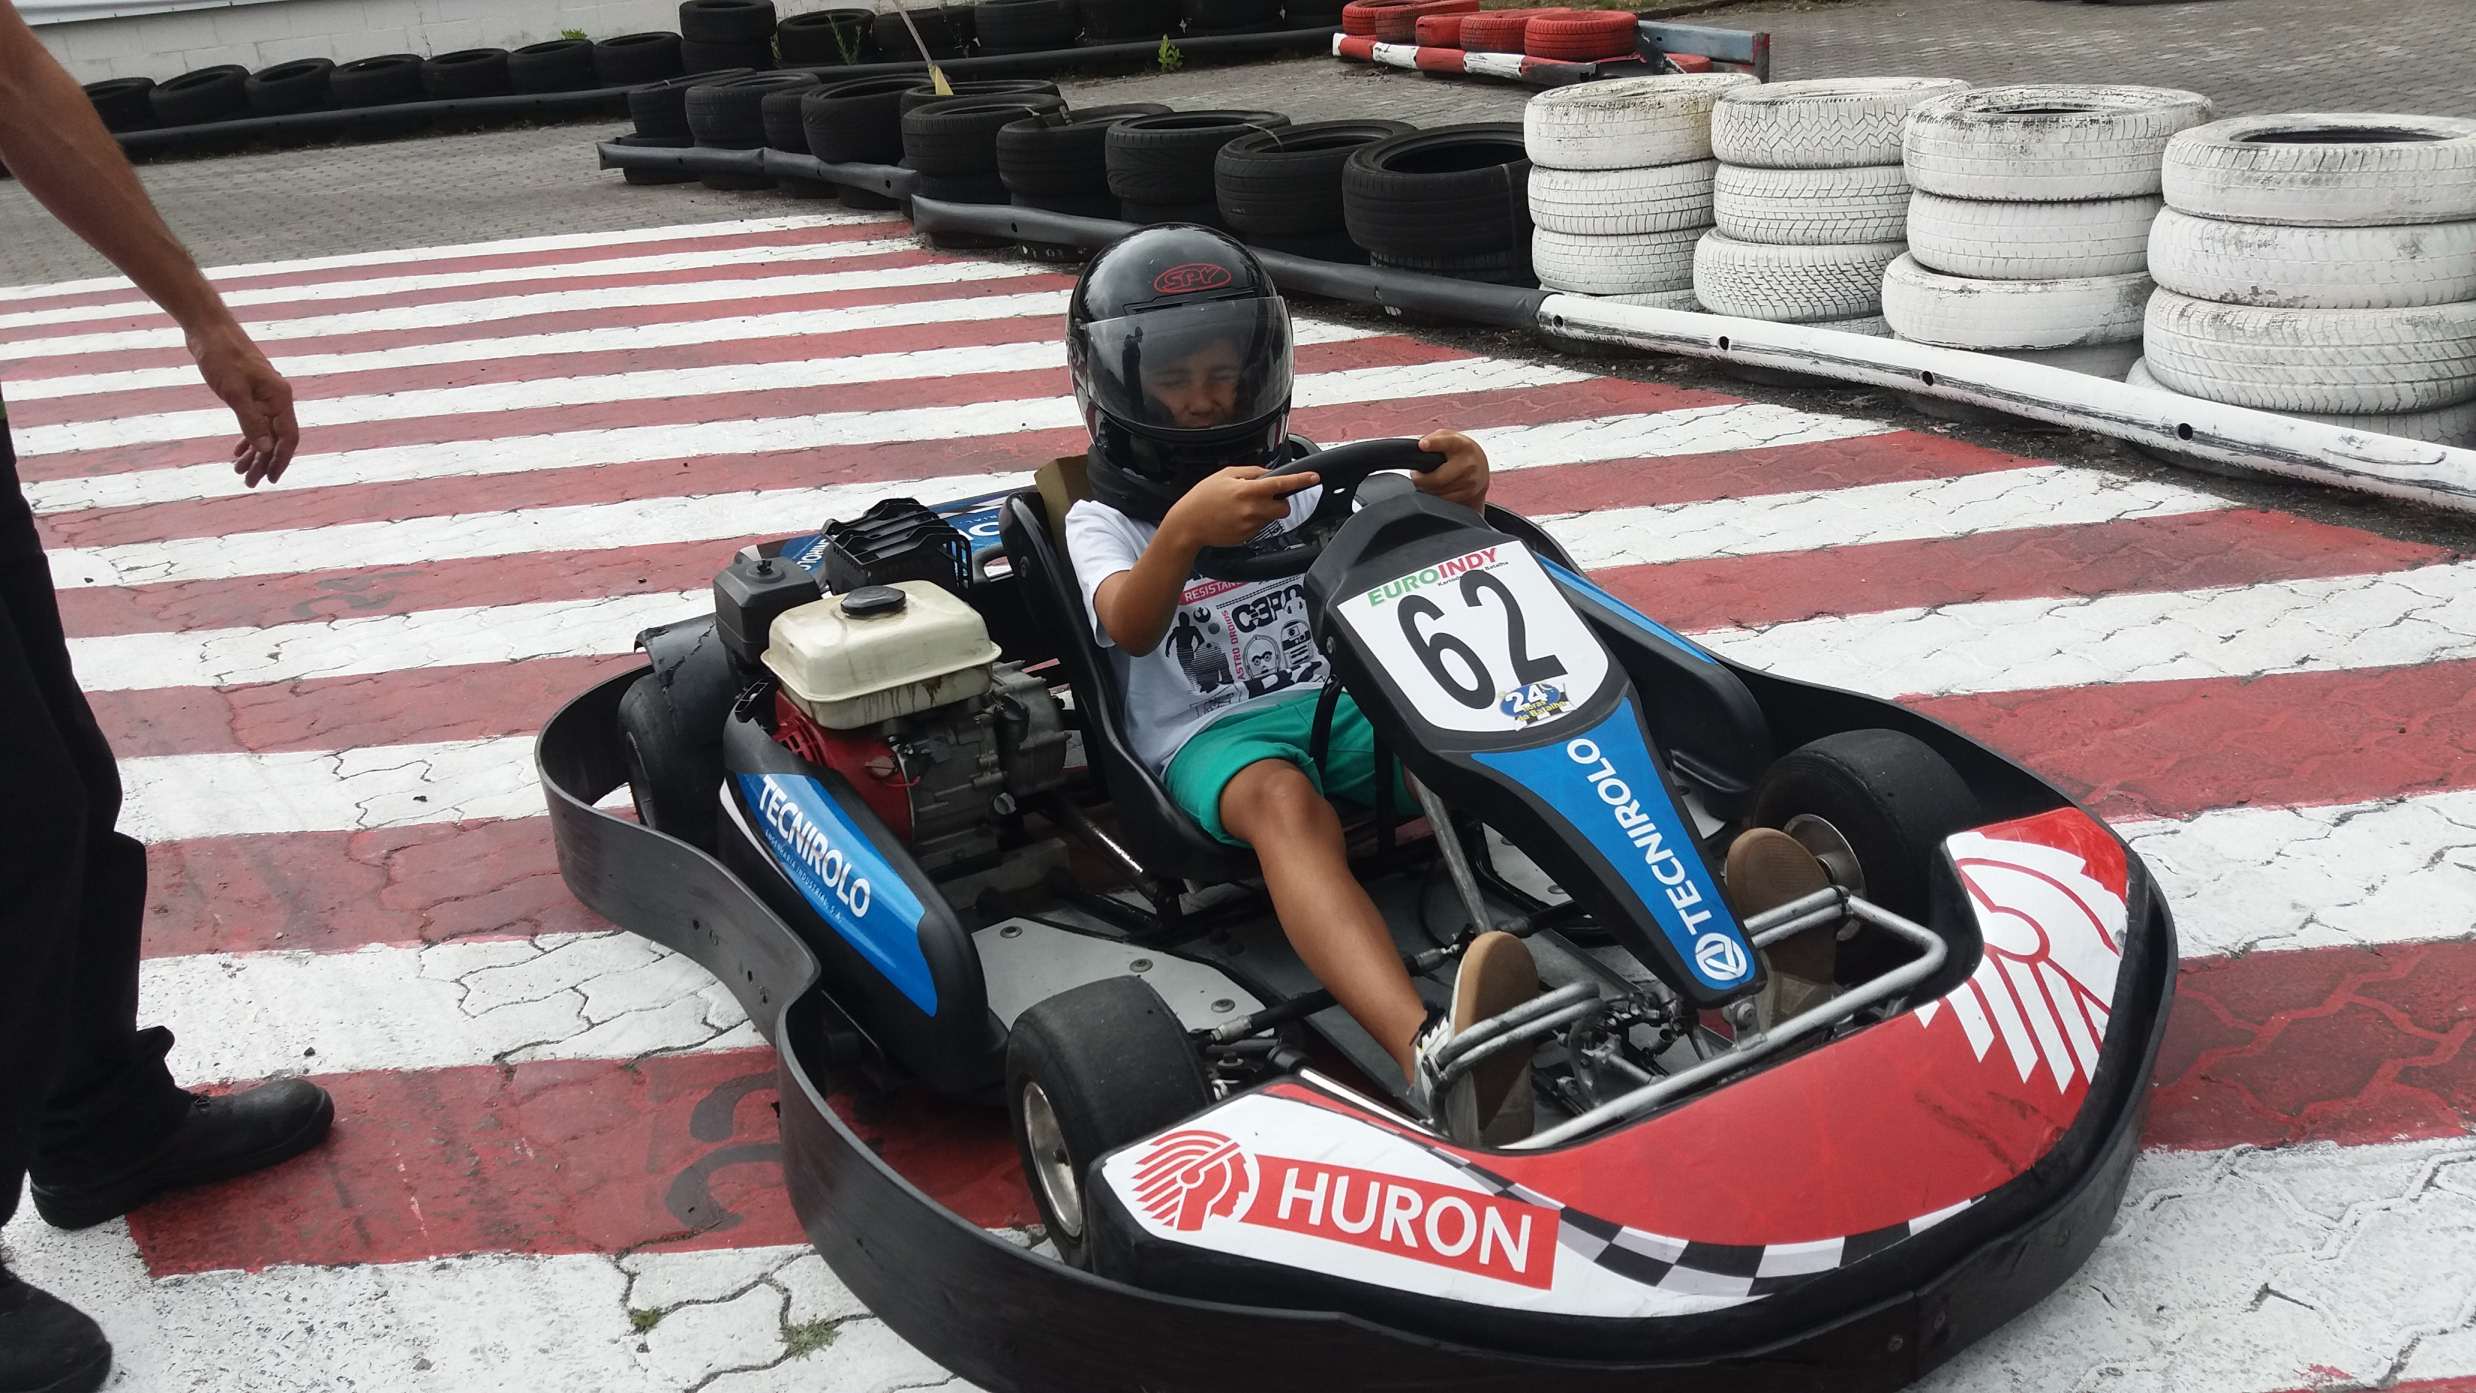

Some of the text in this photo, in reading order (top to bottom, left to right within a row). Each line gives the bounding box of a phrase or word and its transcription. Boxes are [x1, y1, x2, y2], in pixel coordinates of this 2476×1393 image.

[1163, 267, 1219, 288] SPY
[1367, 547, 1498, 608] EUROINDY
[1397, 569, 1568, 709] 62
[1505, 685, 1547, 713] 24
[759, 775, 871, 918] TECNIROLO
[1567, 738, 1712, 936] TECNIROLO
[1277, 1167, 1532, 1273] HURON
